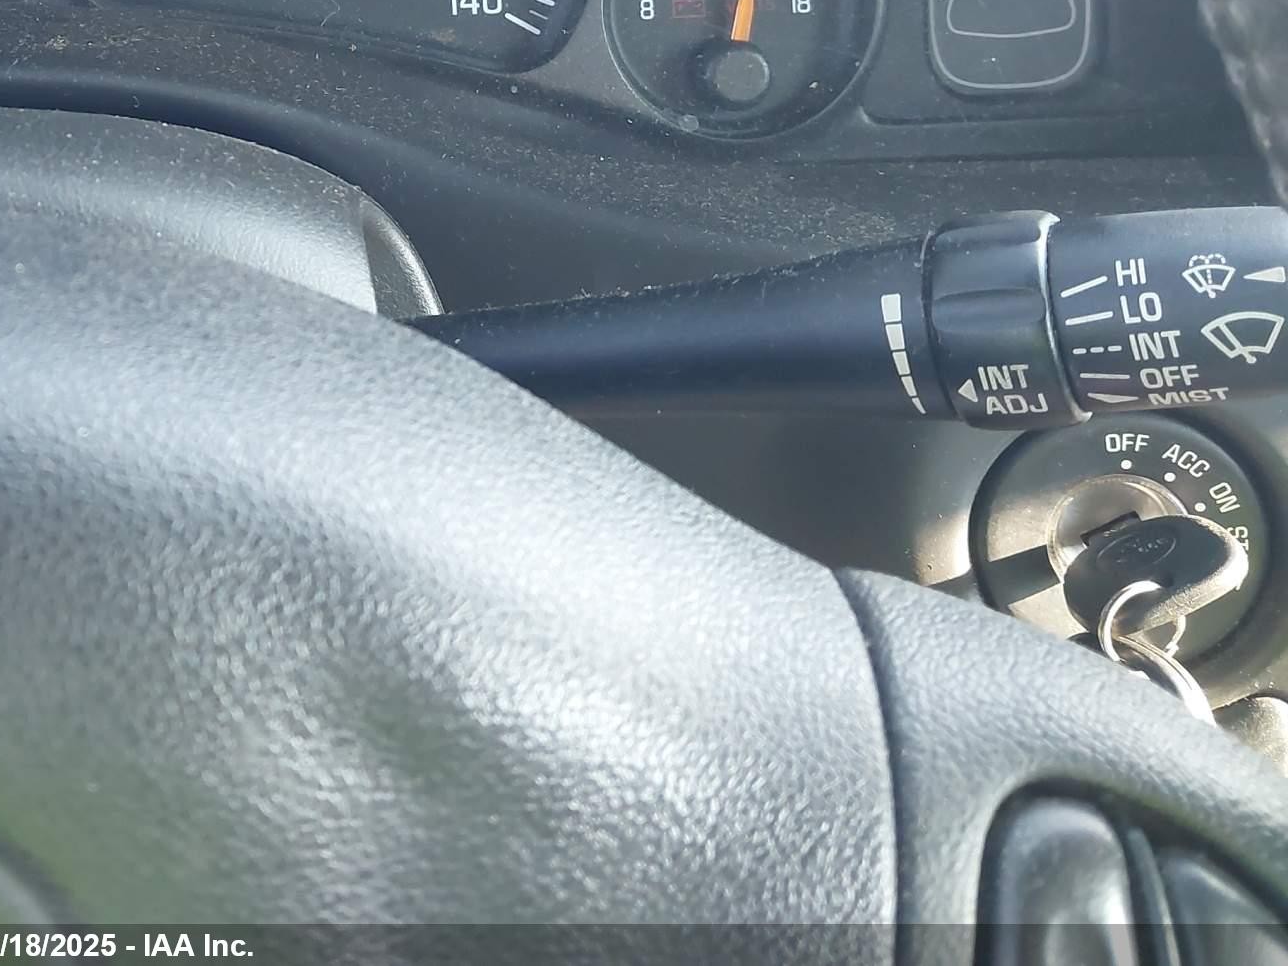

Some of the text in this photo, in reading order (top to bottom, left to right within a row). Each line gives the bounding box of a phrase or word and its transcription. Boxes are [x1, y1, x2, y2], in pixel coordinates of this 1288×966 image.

[1115, 258, 1147, 287] HI
[1120, 291, 1163, 324] LO
[1129, 330, 1182, 361] INT
[977, 364, 1029, 391] INT
[1139, 364, 1200, 389] OFF
[985, 393, 1049, 415] ADJ
[1147, 387, 1230, 406] MIST
[1105, 433, 1150, 453] OFF
[1162, 443, 1211, 479] ACC
[1209, 482, 1241, 515] ON
